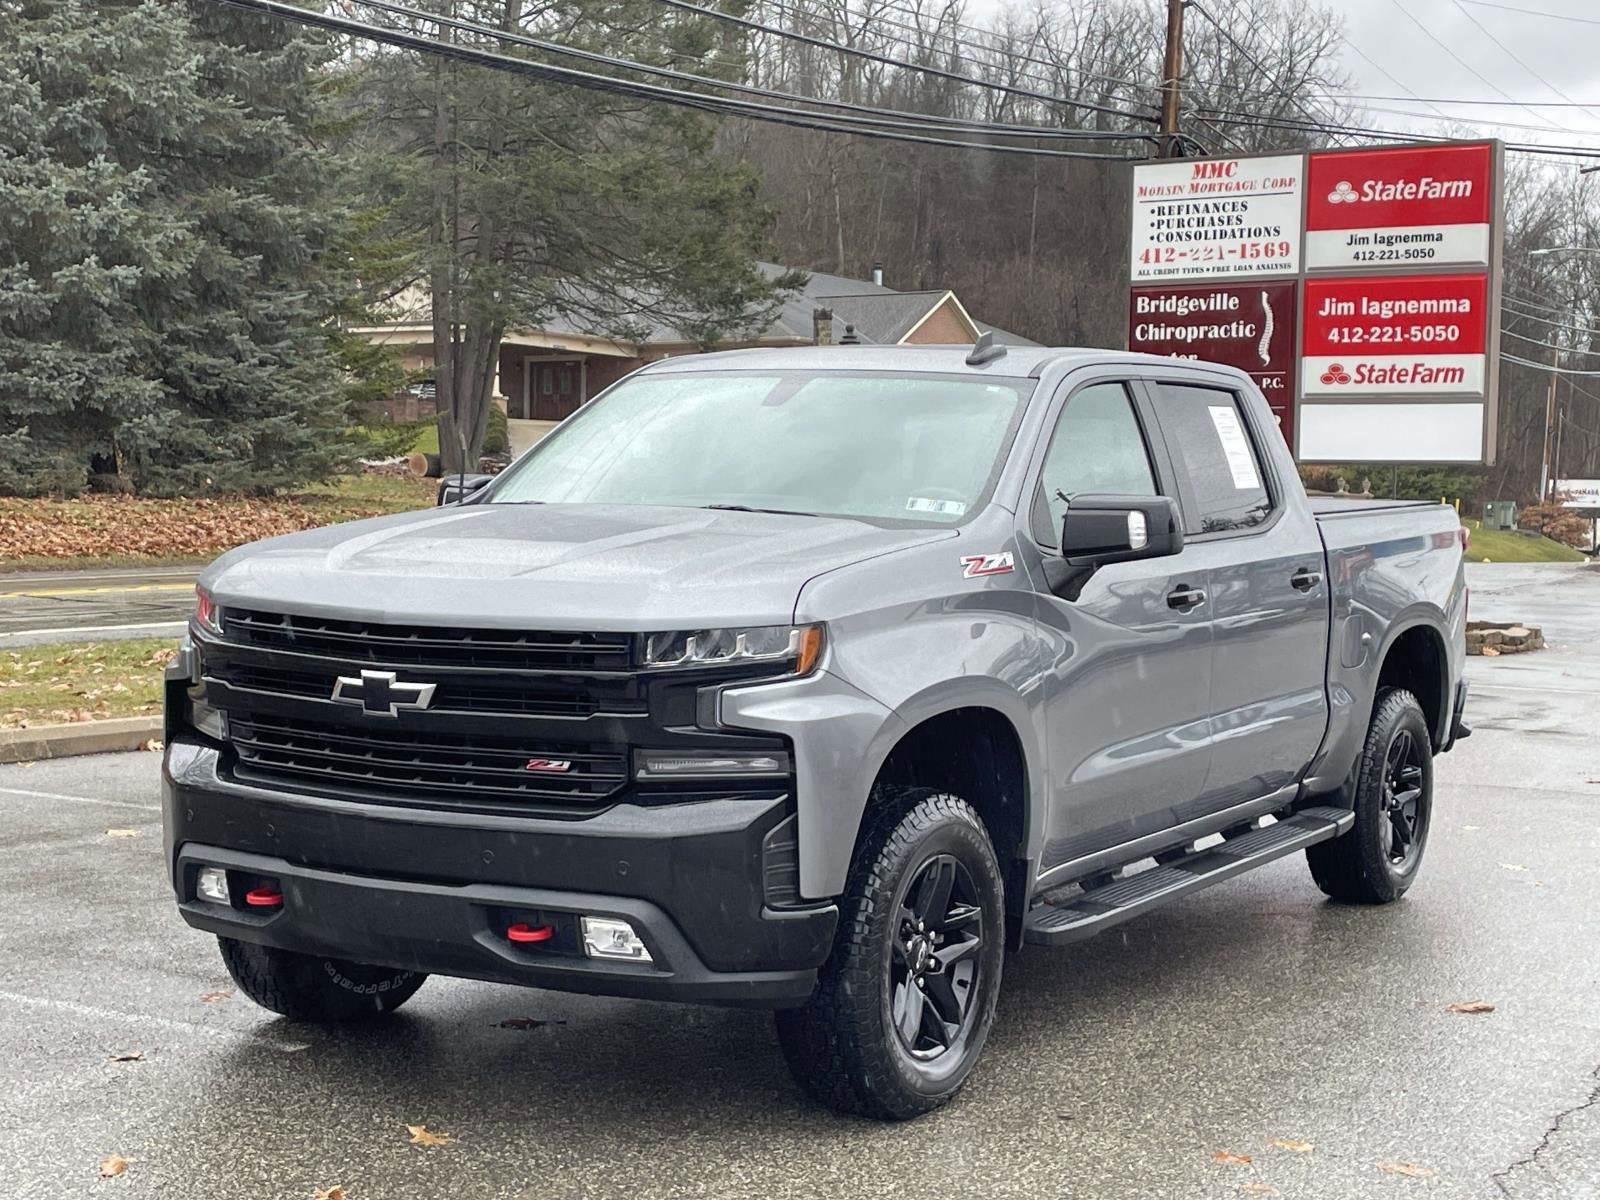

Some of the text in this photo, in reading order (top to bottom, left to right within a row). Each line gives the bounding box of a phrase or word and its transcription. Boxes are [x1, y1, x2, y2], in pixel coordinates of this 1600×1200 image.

[1192, 161, 1238, 180] MMC
[1188, 180, 1258, 195] MORTGAGE
[1157, 201, 1249, 217] REFINANCES
[1156, 215, 1244, 230] PURCHASES
[1156, 226, 1281, 243] CONSOLIDATIONS
[1346, 232, 1444, 248] Jim Iagnemma
[1139, 241, 1291, 265] 412-221-1569
[1353, 248, 1435, 262] 412-221-5050
[1137, 262, 1292, 277] ALL CREDIT TYPES FREE LOAN ANALYSIS
[1136, 293, 1240, 316] Bridgeville
[1318, 297, 1471, 319] Jim Iagnemma
[1135, 320, 1256, 343] Chiropractic
[1328, 325, 1460, 343] 412-221-5050
[1262, 377, 1285, 389] P.C.
